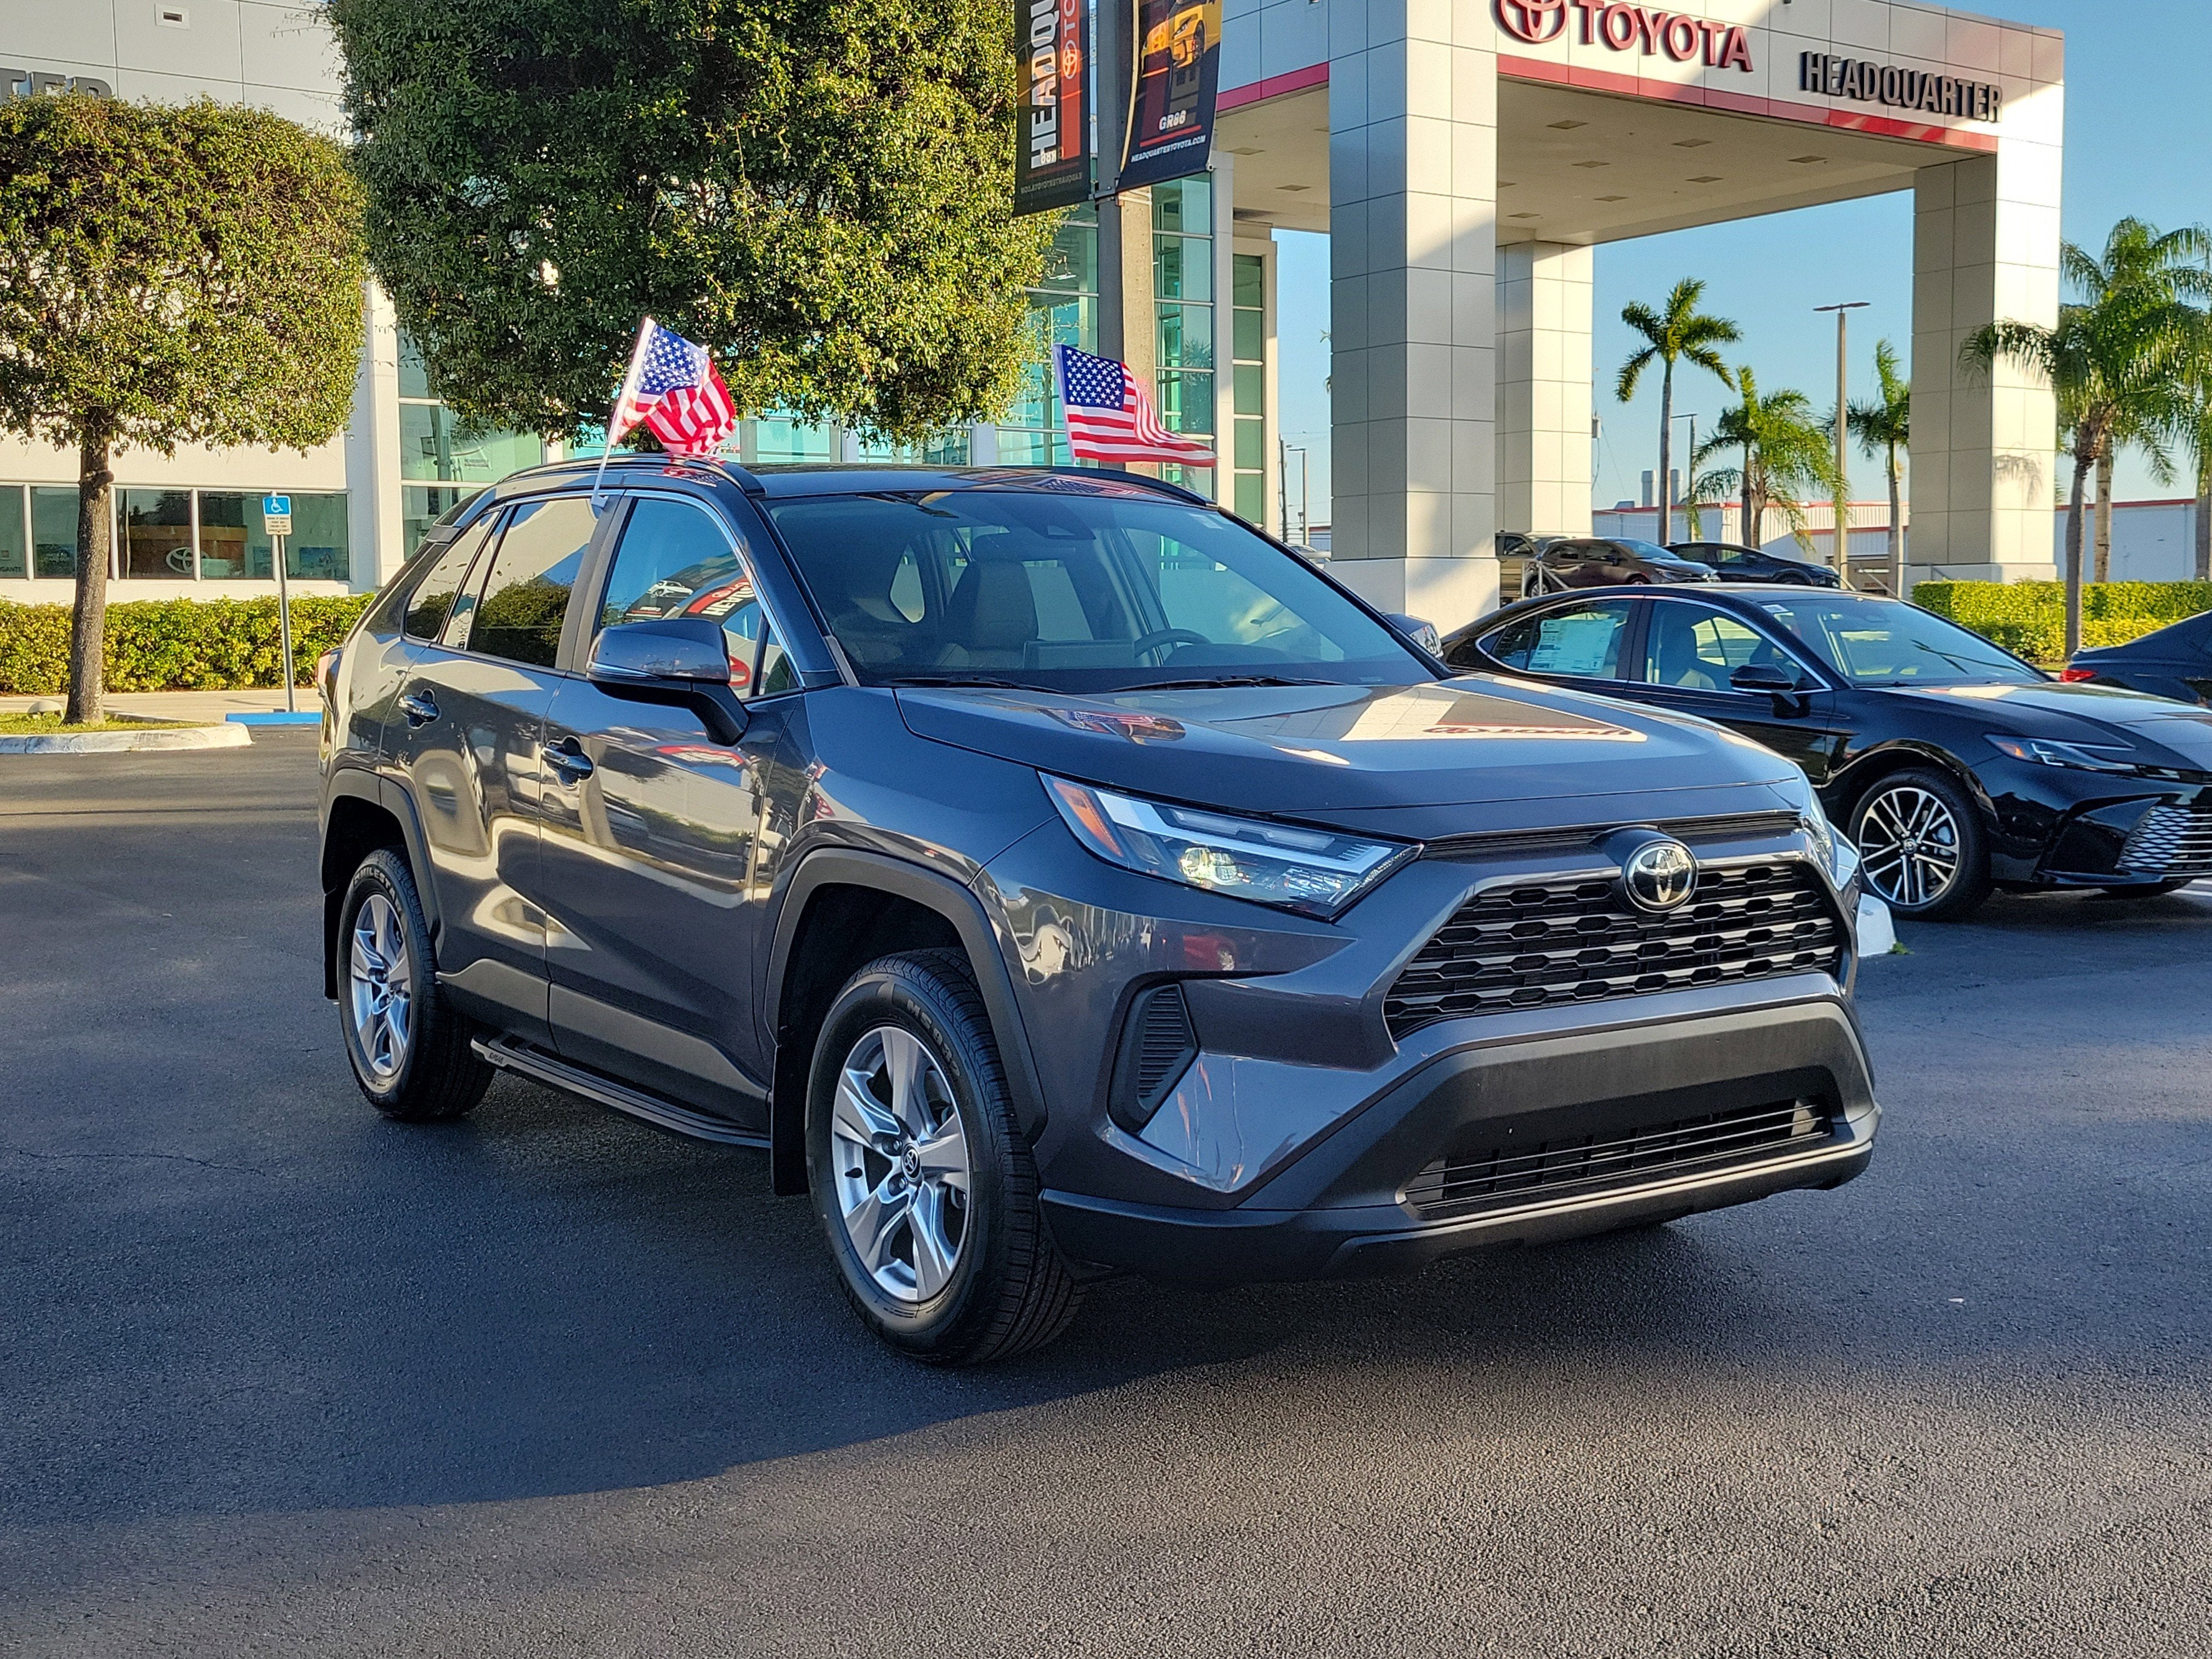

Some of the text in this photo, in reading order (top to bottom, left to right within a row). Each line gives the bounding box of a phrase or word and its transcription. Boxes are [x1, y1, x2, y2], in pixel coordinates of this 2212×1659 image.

[1572, 0, 1753, 72] TOYOTA
[1159, 110, 1186, 130] GR86
[1802, 52, 2002, 122] HEADQUARTER
